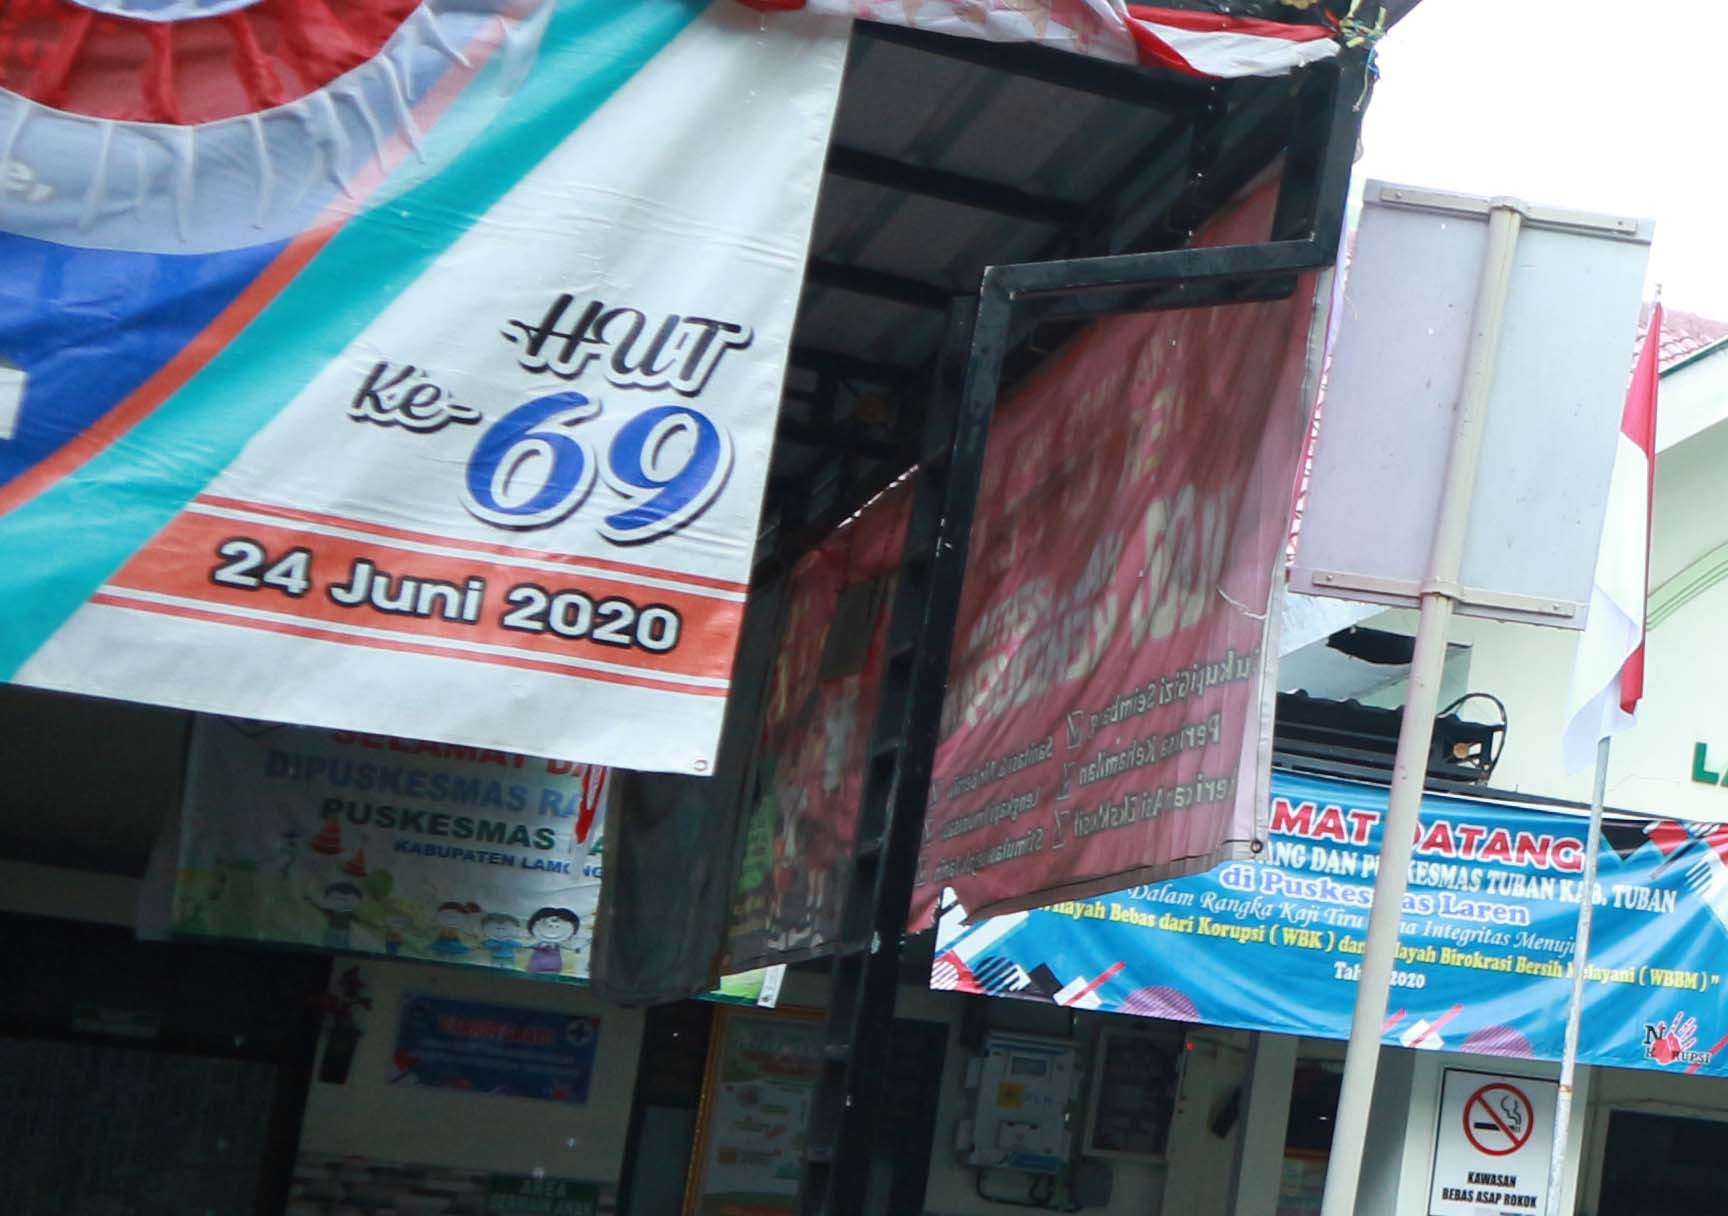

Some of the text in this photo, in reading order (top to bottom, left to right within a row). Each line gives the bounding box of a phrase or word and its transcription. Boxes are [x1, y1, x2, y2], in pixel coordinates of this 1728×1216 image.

[502, 293, 752, 397] HUT
[461, 391, 734, 546] 69
[210, 538, 682, 654] 24 Juni 2020
[319, 798, 556, 851] PUSKESMAS
[394, 839, 516, 868] KABUPATEN
[1221, 865, 1530, 926] di Puskesas Laren
[1309, 846, 1359, 876] DAN
[1486, 869, 1560, 899] TUBAN
[1612, 884, 1678, 913] TUBAN
[1110, 903, 1156, 927] Bebas
[1159, 914, 1195, 932] dari
[1198, 918, 1265, 944] Korupsi
[1282, 927, 1323, 950] WBK
[1439, 946, 1513, 973] Birokrasi
[1515, 955, 1562, 978] Bersih
[1649, 968, 1699, 990] WBBM
[1128, 884, 1194, 908] Dalam
[1200, 891, 1273, 921] Rangka
[1278, 900, 1321, 929] Kaji
[1423, 920, 1510, 949] Integritas
[1390, 970, 1426, 989] 2020
[1442, 1187, 1537, 1208] BEBAS ASAP ROKOK
[1467, 1171, 1517, 1188] KAWASAN
